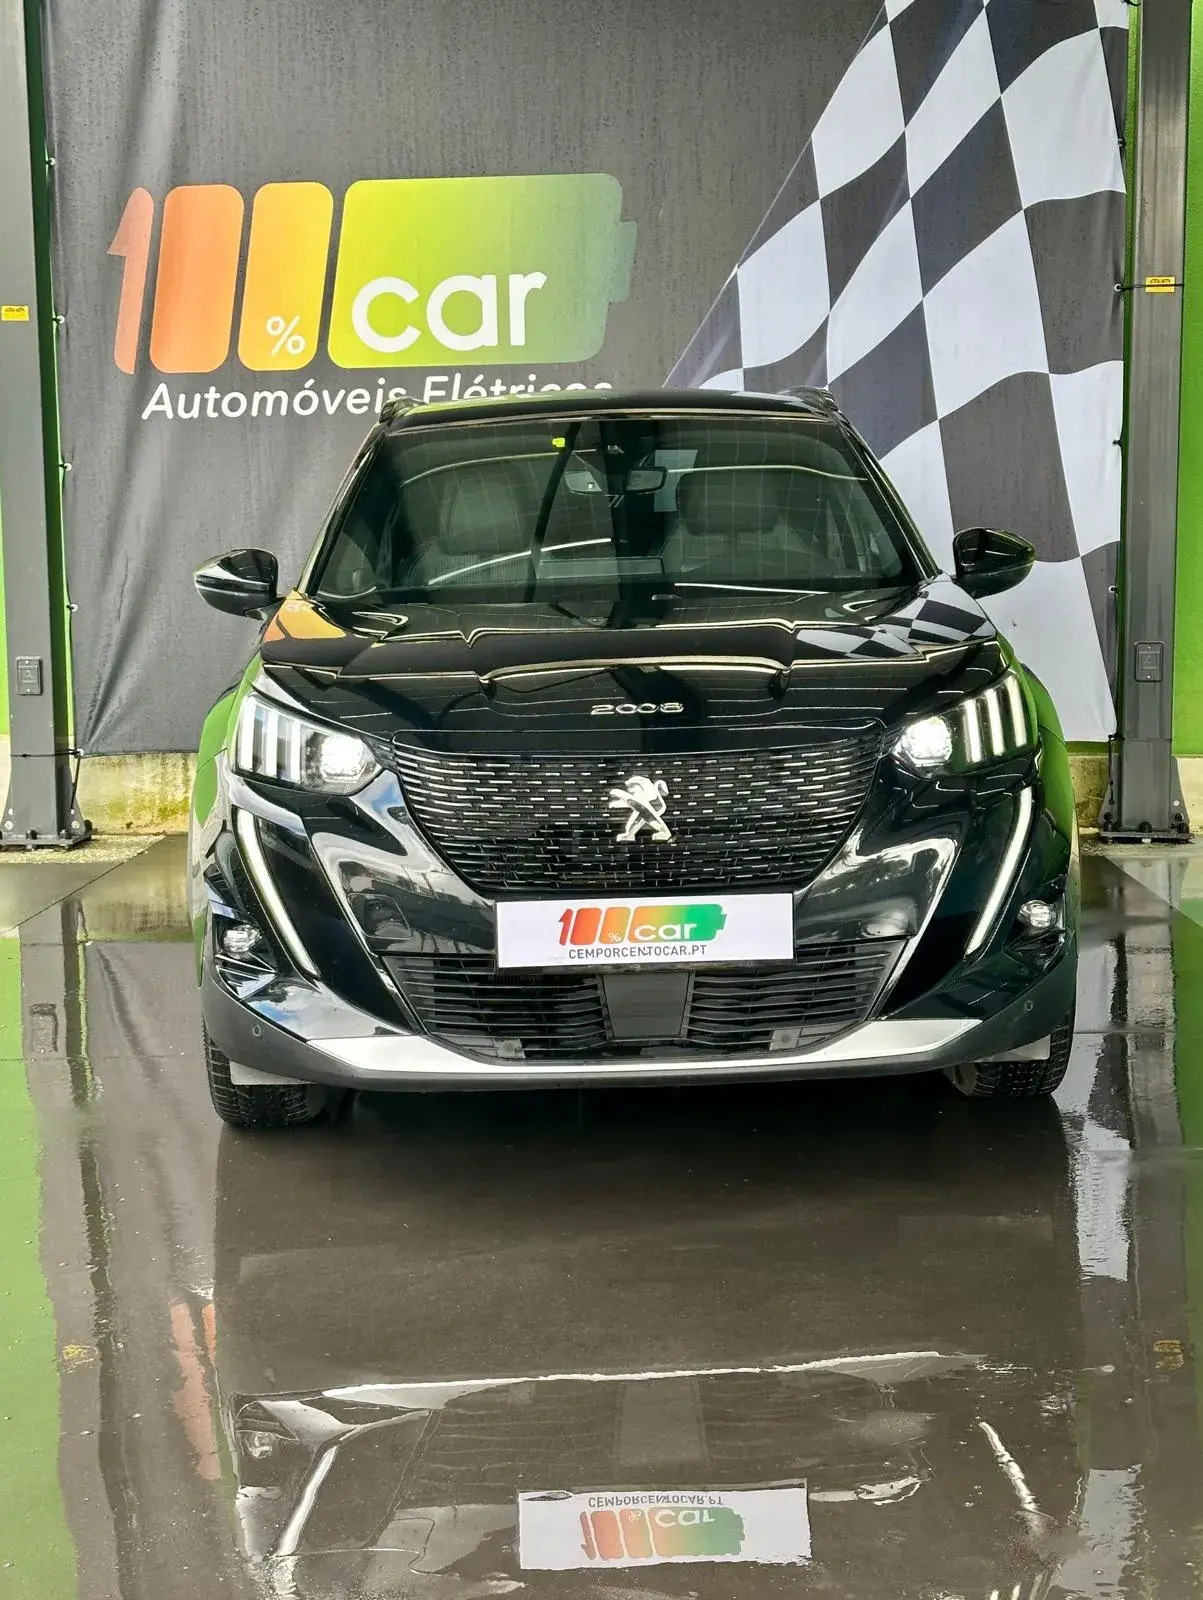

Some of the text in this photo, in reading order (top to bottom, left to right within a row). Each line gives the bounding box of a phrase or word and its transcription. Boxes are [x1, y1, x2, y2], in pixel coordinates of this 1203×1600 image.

[351, 271, 548, 353] car
[423, 372, 613, 404] Elétri
[590, 702, 684, 716] 2008
[633, 921, 697, 941] car
[568, 944, 708, 960] CEMPORCENTOCAR.PT
